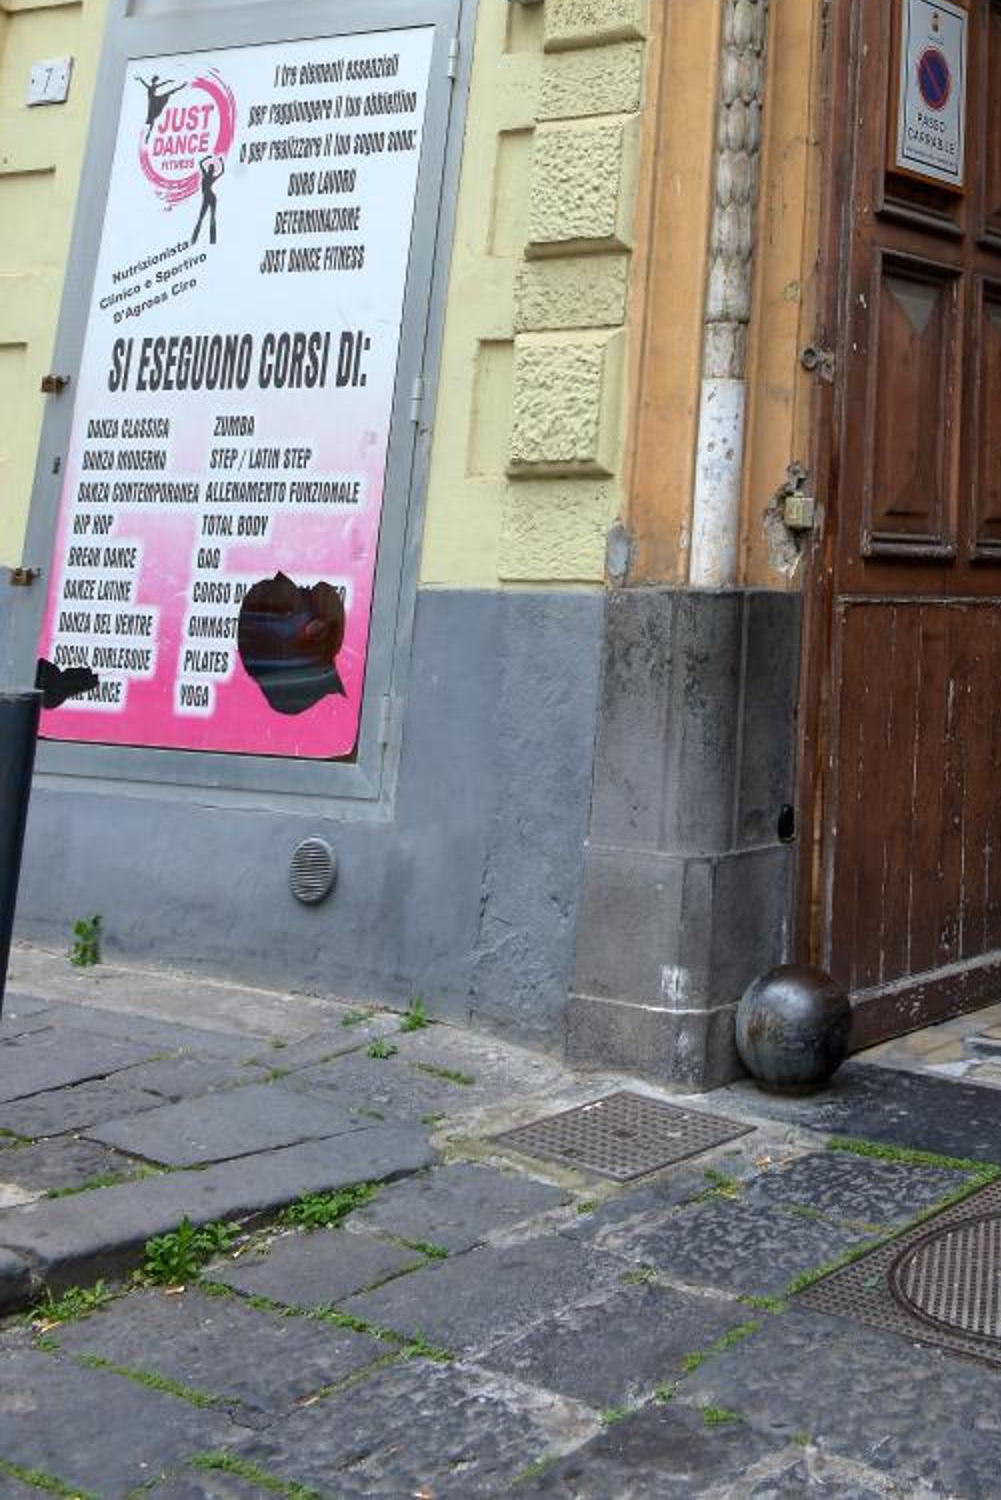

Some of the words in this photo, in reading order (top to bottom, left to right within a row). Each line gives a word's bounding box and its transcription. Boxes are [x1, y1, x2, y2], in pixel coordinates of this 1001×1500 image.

[346, 53, 399, 81] essenziali
[158, 104, 215, 134] JUST
[917, 111, 945, 133] PASSO
[152, 131, 210, 157] DANCE
[248, 141, 267, 164] per
[268, 134, 323, 160] realizzare
[907, 126, 955, 155] CARRABILE
[317, 167, 356, 195] LAVORO
[273, 205, 361, 235] DETERMINAZIONE
[112, 240, 189, 284] Nutrizionista
[259, 248, 287, 274] JUST
[287, 247, 322, 273] DANCE
[323, 243, 365, 271] FITNESS
[99, 284, 141, 310] Clinico
[144, 279, 153, 289] e
[155, 253, 207, 283] Sportivo
[171, 278, 197, 296] Ciro
[108, 337, 134, 392] SI
[135, 333, 253, 392] ESEGUONO
[258, 331, 331, 389] CORSI
[335, 329, 371, 388] DI:
[87, 419, 119, 439] DANZA
[121, 417, 170, 439] CLASSICA
[213, 415, 255, 437] ZUMBA
[82, 449, 115, 471] DANZA
[210, 448, 239, 469] STEP
[248, 447, 281, 469] LATIN
[283, 447, 313, 469] STEP
[77, 481, 110, 503] DANZA
[111, 481, 200, 503] CONTEMPORANEA
[205, 481, 287, 503] ALLENAMENTO
[288, 481, 361, 504] FUNZIONALE
[73, 513, 91, 535] HIP
[91, 513, 114, 535] HOP
[201, 514, 233, 536] TOTAL
[237, 515, 269, 537] BODY
[67, 546, 101, 567] BREAK
[103, 547, 137, 569] DANCE
[63, 579, 97, 600] DANZE
[97, 580, 132, 601] LATINE
[193, 581, 231, 605] CORSO
[59, 611, 91, 633] DANZA
[93, 613, 112, 634] DEL
[115, 614, 153, 637] VENTRE
[92, 647, 151, 671] BURLESQUE
[183, 649, 229, 674] PILATES
[179, 683, 209, 707] YOGA
